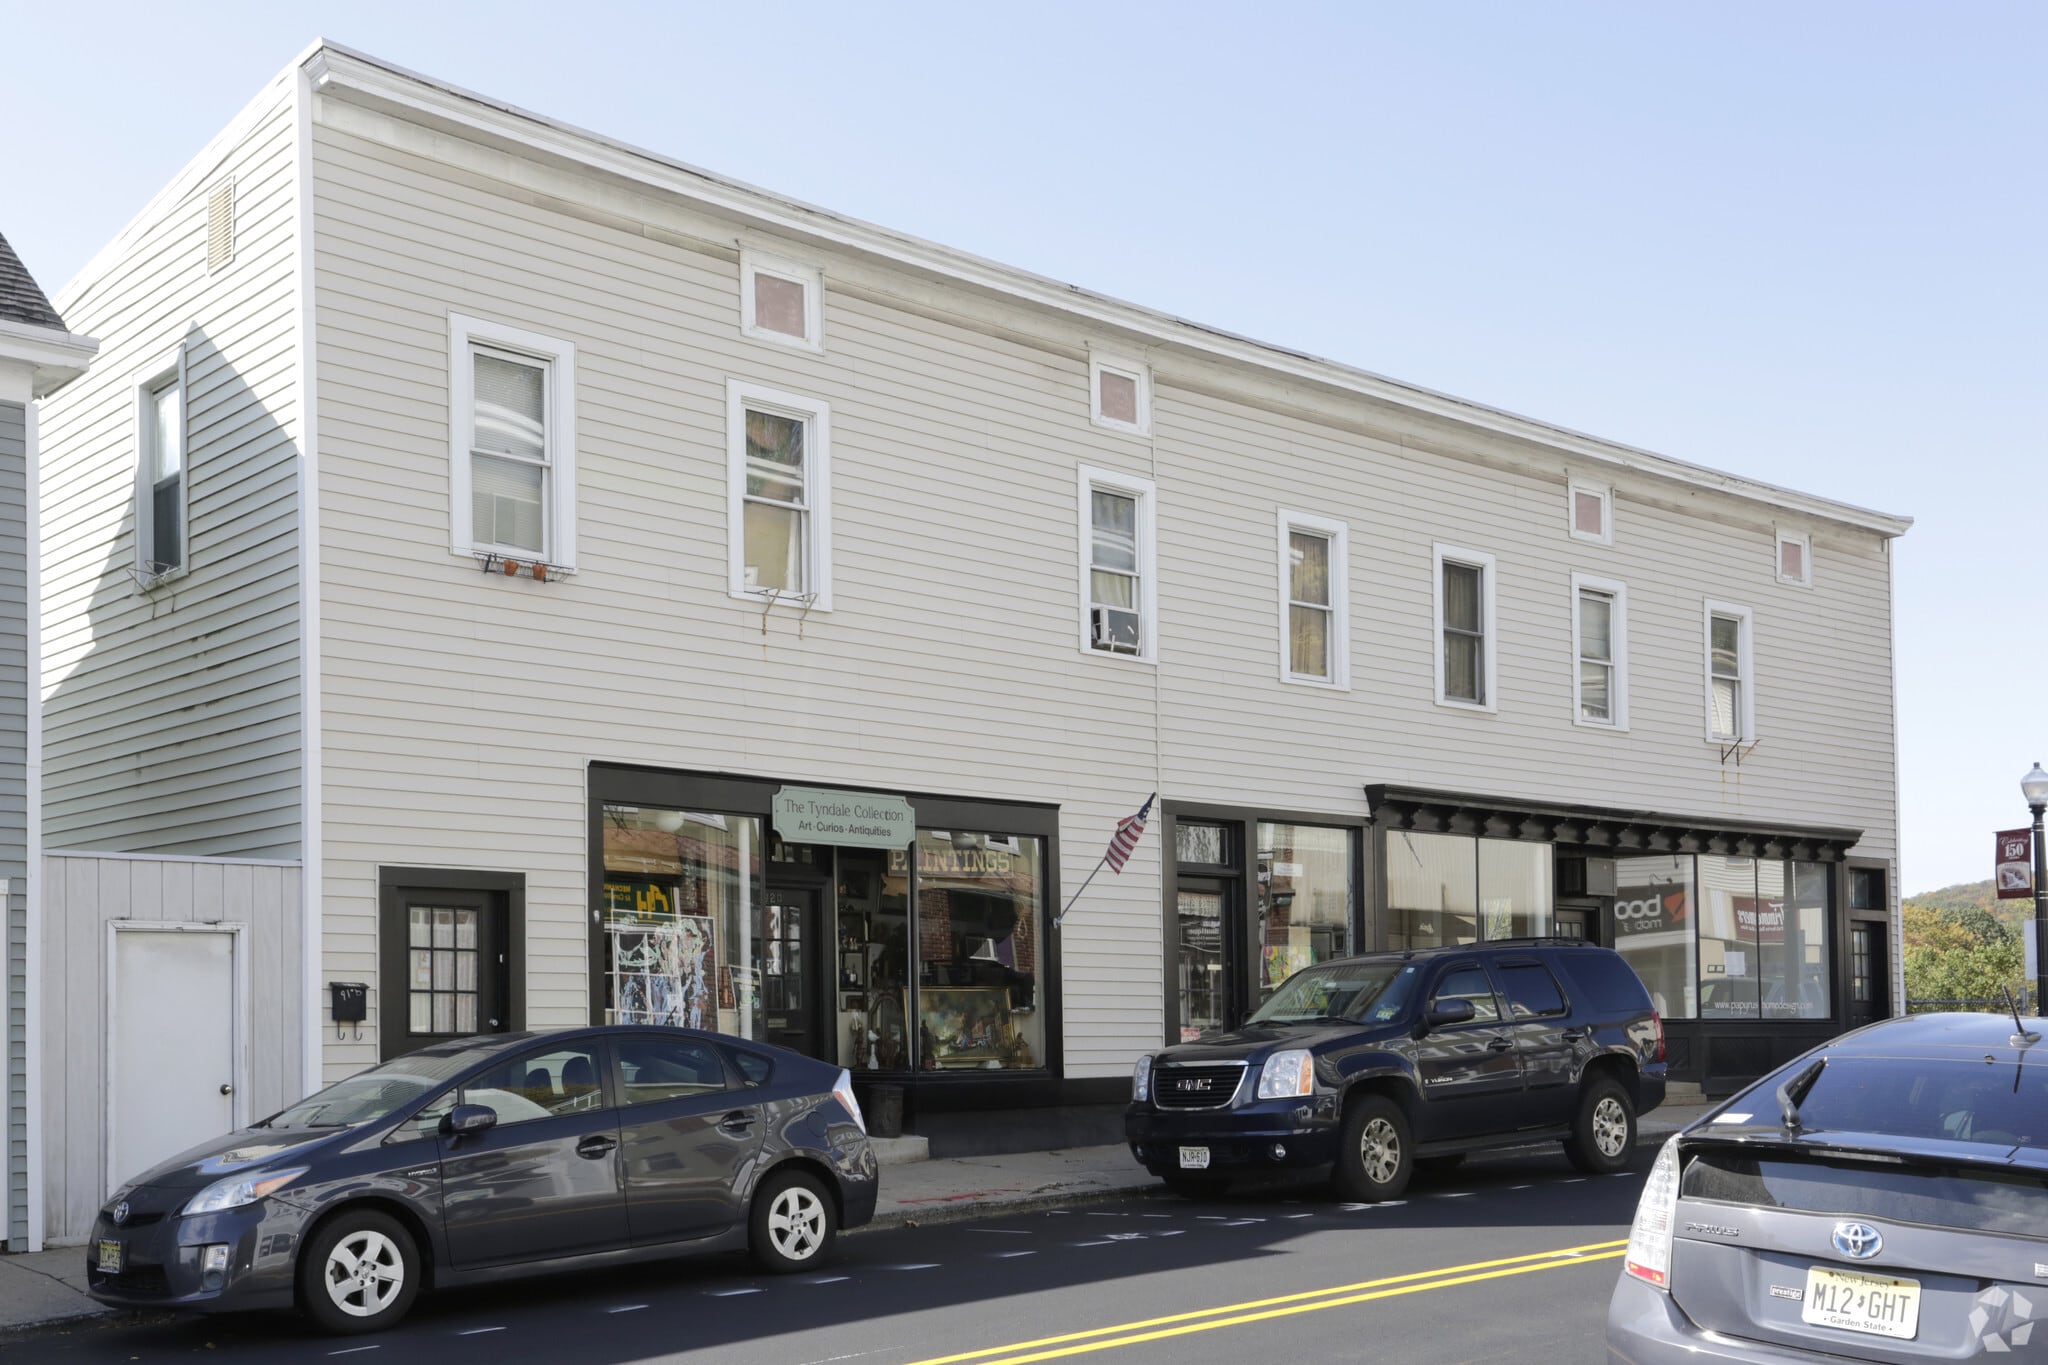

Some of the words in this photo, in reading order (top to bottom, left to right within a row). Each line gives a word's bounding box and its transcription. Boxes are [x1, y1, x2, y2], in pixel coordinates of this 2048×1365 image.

[783, 799, 805, 813] The
[807, 800, 851, 818] Tyndale
[854, 805, 904, 821] Collection
[848, 824, 892, 837] Antiquities
[2005, 842, 2025, 857] 150
[891, 849, 1010, 873] PINTINGS
[1176, 1079, 1212, 1091] GMC
[1684, 1221, 1739, 1237] PRIUS
[1835, 1272, 1856, 1284] New
[1860, 1275, 1890, 1289] Jersey
[1830, 1315, 1861, 1328] Garden
[1863, 1321, 1887, 1332] State
